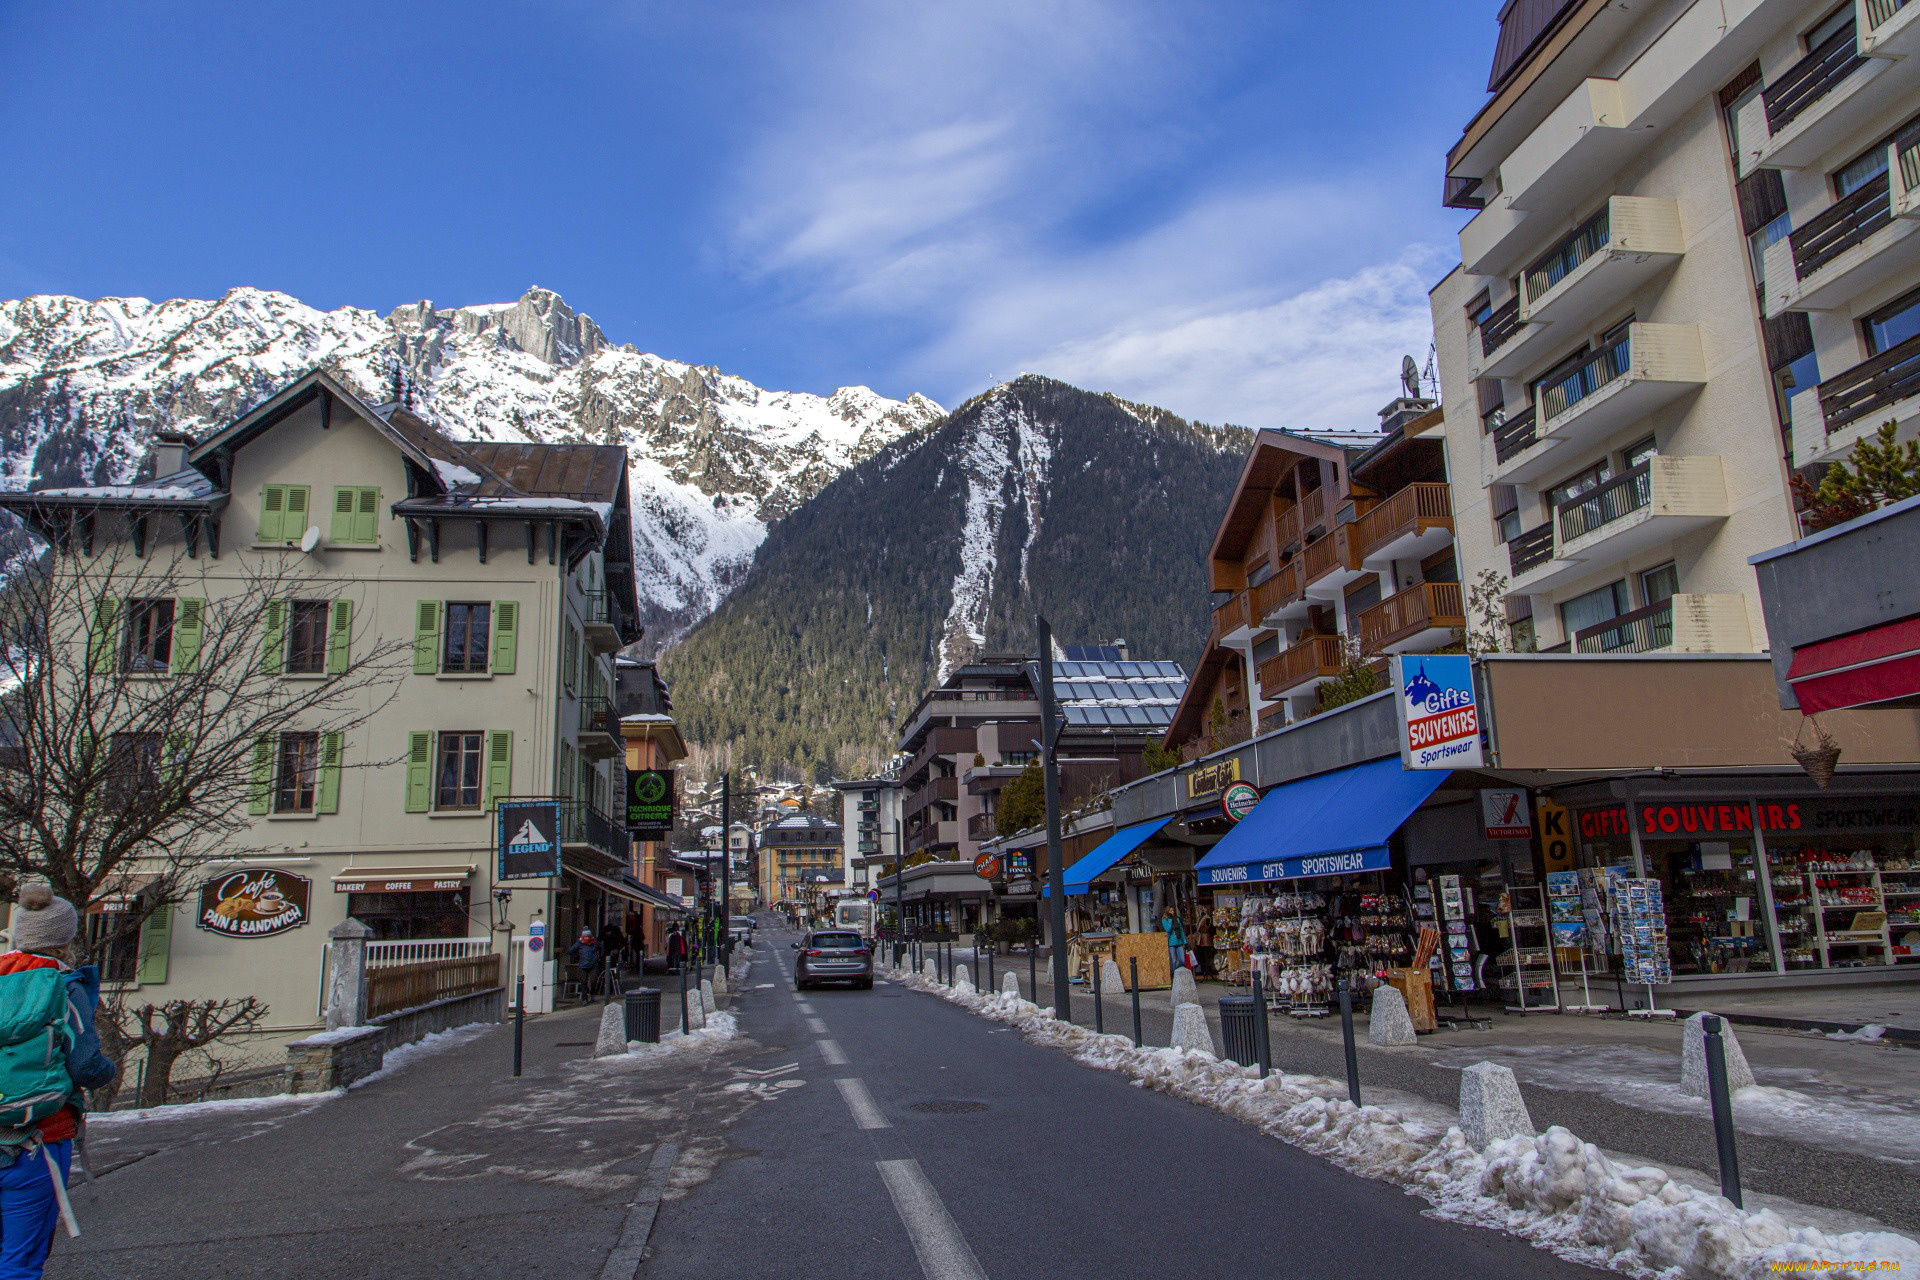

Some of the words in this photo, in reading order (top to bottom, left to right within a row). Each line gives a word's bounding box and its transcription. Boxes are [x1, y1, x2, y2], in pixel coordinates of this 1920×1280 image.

[1425, 687, 1471, 714] Gifts
[1420, 741, 1473, 767] Sportswear
[1229, 799, 1259, 809] Heineken
[1581, 808, 1630, 839] GIFTS
[1643, 803, 1802, 834] SOUVENIRS
[1815, 808, 1919, 829] SPORTSWEAR
[509, 843, 550, 855] LEGEND
[976, 854, 995, 873] CHAM
[1211, 866, 1248, 882] SOUVENIRS
[1263, 863, 1285, 879] GIFTS
[1302, 853, 1364, 875] SPORTSWEAR
[218, 872, 276, 901] Café
[336, 882, 366, 891] BAKERY
[385, 882, 412, 890] COFFEE
[434, 880, 461, 889] PASTRY
[203, 908, 231, 930] PAIN
[230, 920, 239, 932] &
[240, 905, 302, 934] SANDWICH
